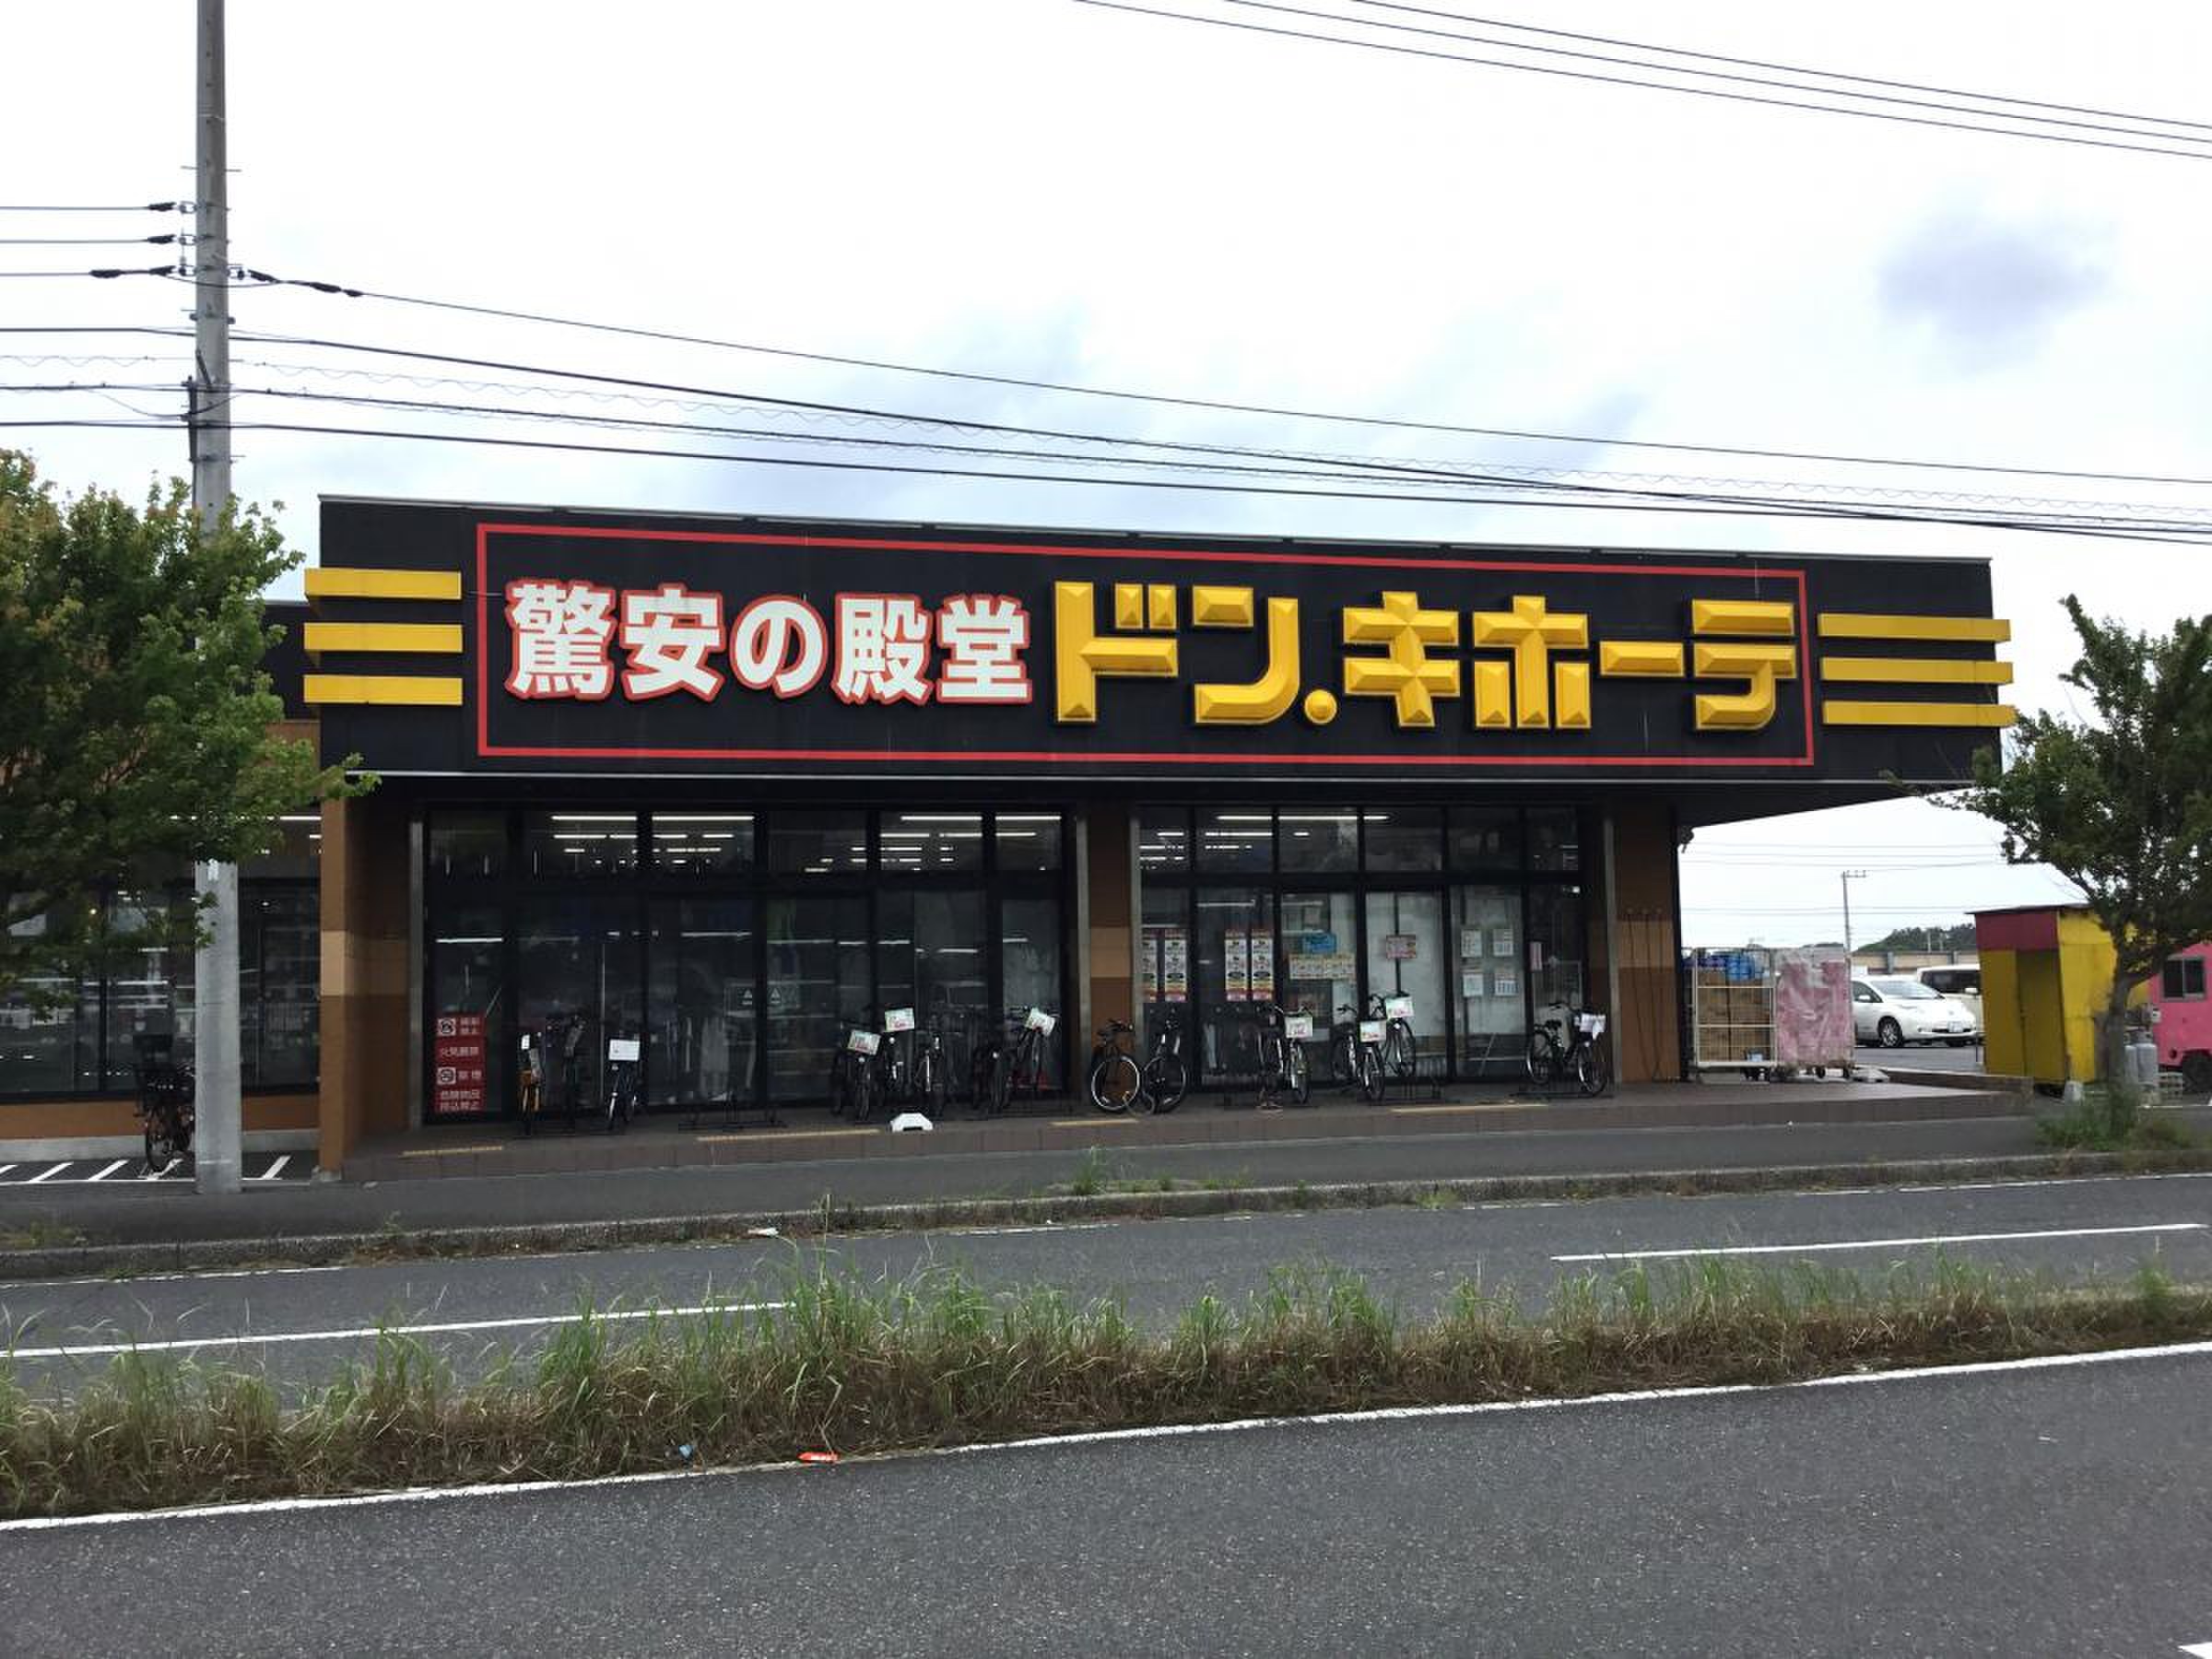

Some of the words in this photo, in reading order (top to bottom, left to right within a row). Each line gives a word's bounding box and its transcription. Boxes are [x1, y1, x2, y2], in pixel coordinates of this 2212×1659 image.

[506, 582, 1033, 703] 驚安の殿堂
